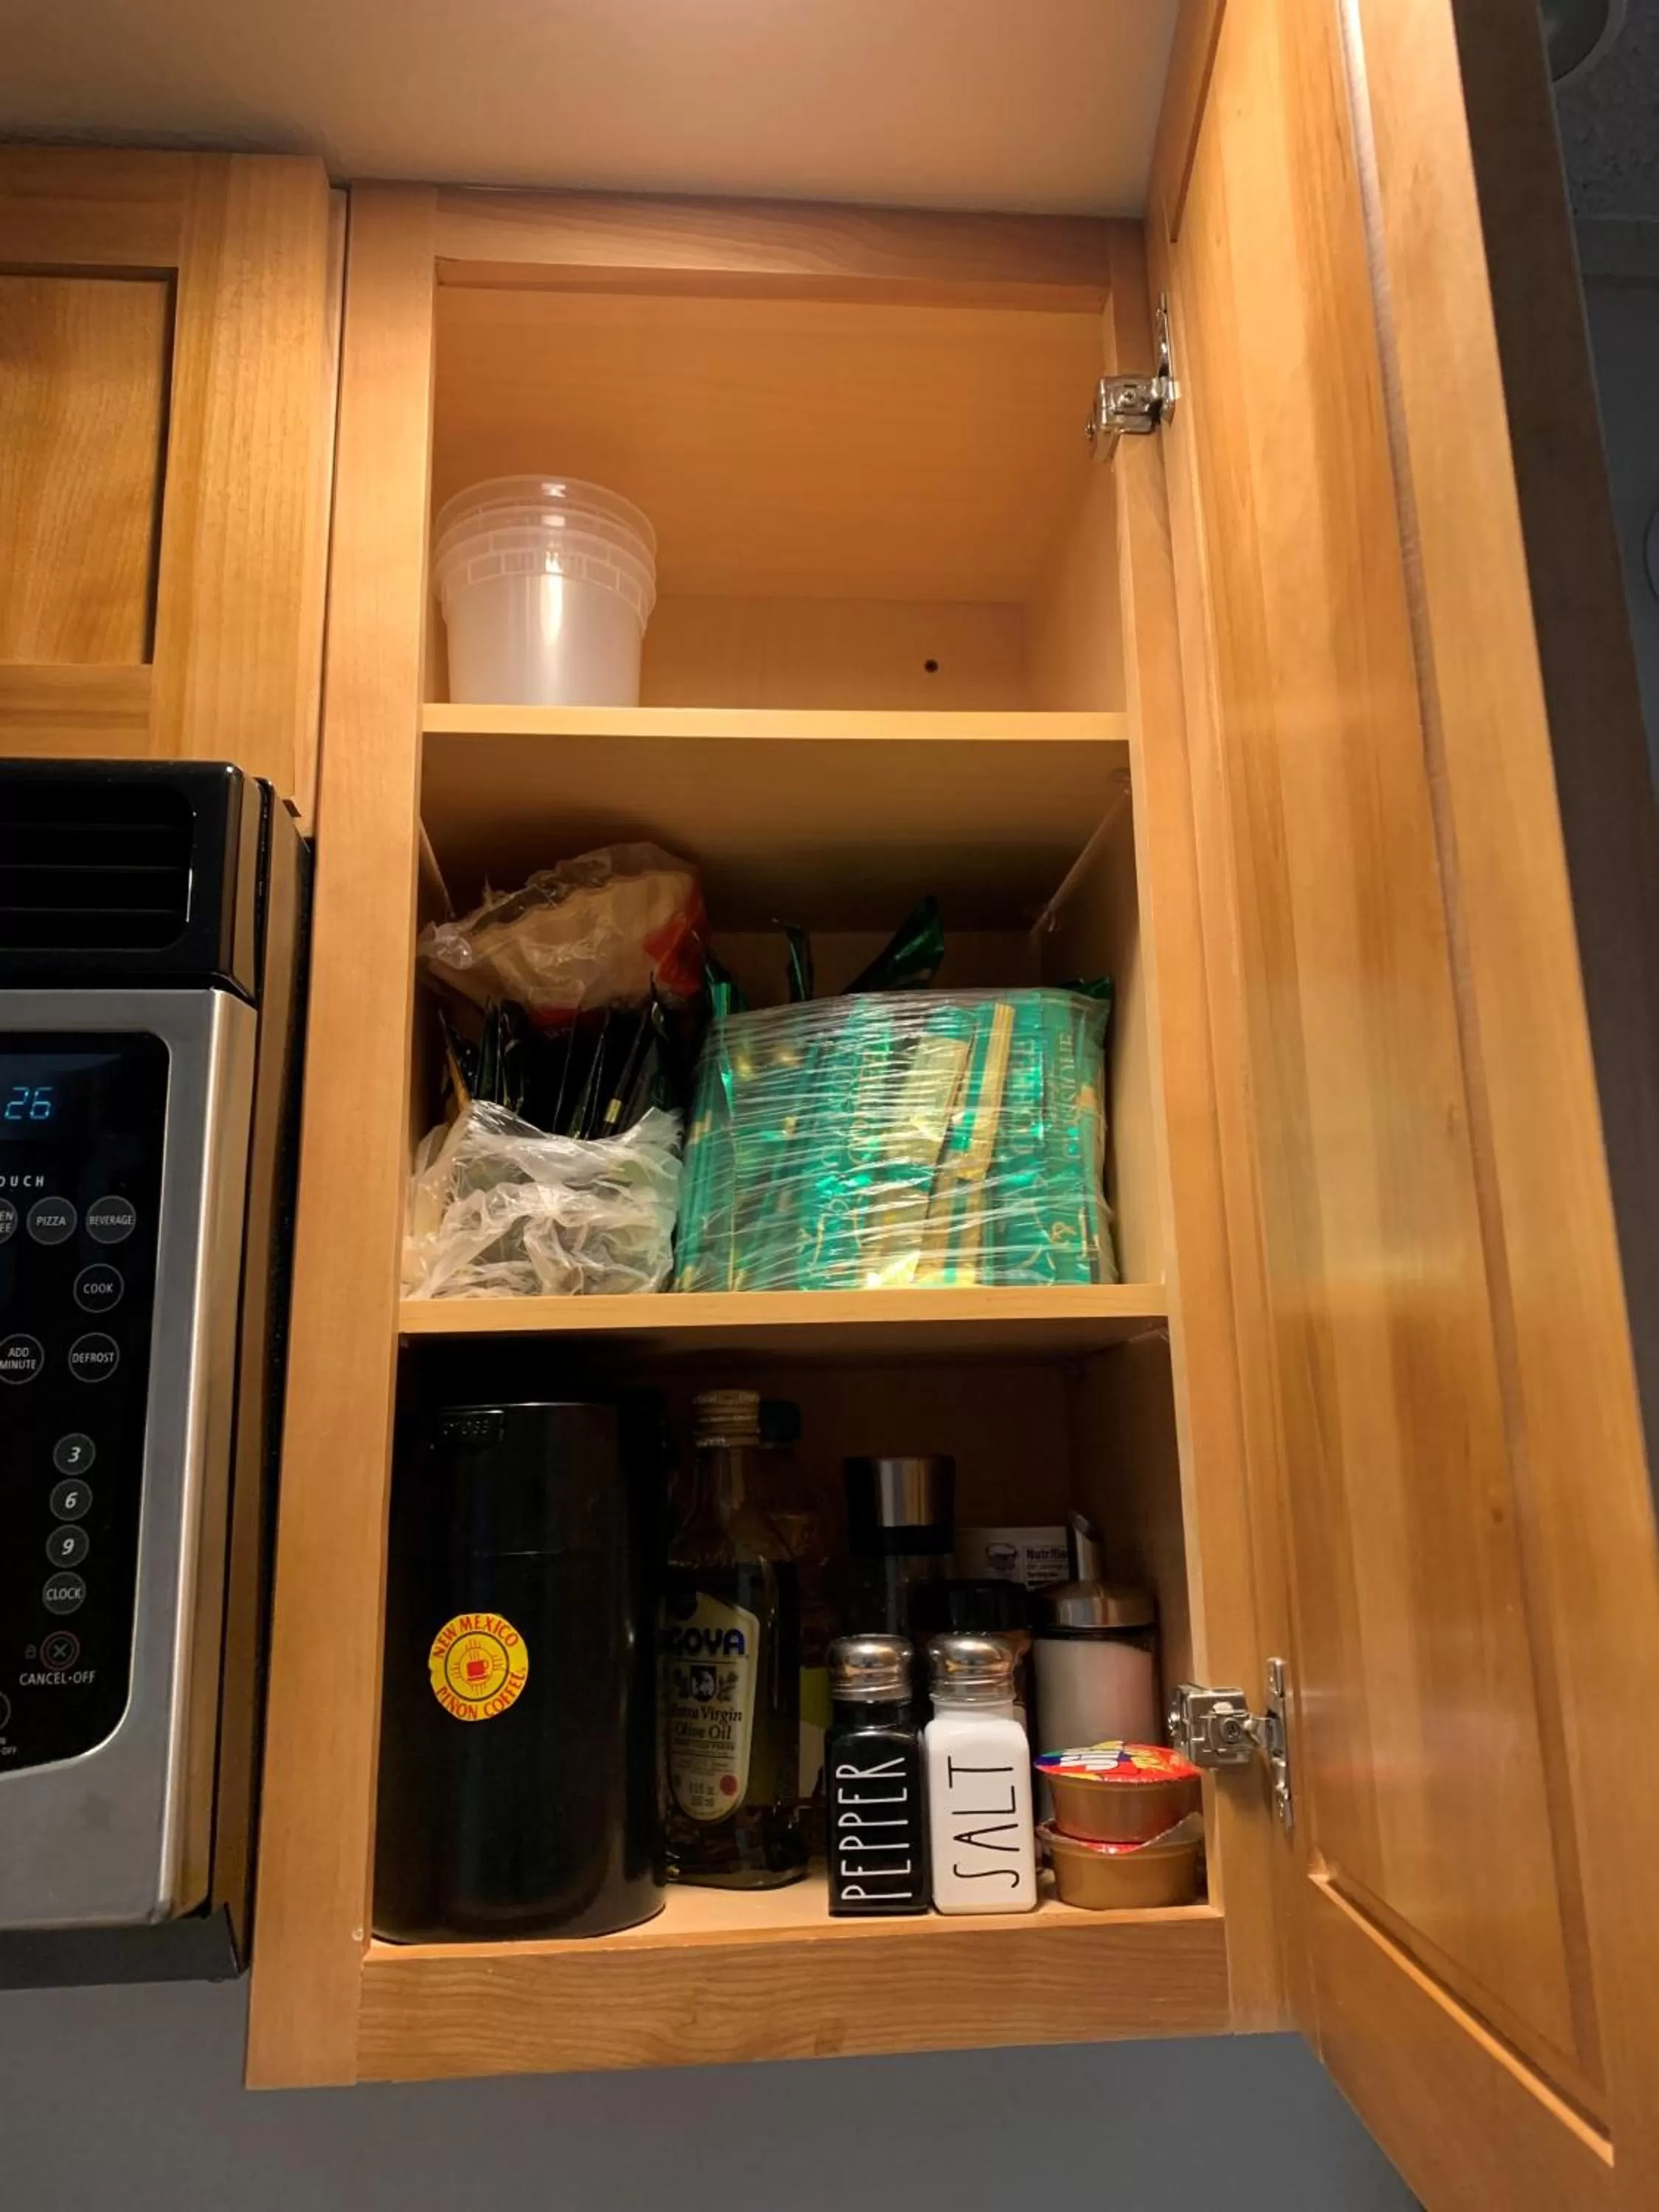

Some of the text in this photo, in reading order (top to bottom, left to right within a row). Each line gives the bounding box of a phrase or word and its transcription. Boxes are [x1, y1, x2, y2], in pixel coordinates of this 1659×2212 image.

[36, 1216, 67, 1227] PIZZA
[88, 1214, 134, 1225] BEVERAGE
[83, 1282, 114, 1294] COOK
[7, 1347, 29, 1357] ADD
[72, 1352, 114, 1363] DEFROST
[0, 1359, 36, 1370] MINUTE
[67, 1446, 82, 1463] 3
[64, 1492, 79, 1509] 6
[61, 1538, 74, 1556] 9
[46, 1587, 83, 1601] CLOCK
[433, 1615, 519, 1659] NEW MEXICO
[665, 1626, 745, 1656] GOYA
[483, 1666, 526, 1717] COFFEE
[700, 1705, 742, 1725] Virgin
[675, 1722, 731, 1740] Olive Oil
[835, 1756, 913, 1901] PEPPER
[947, 1755, 1021, 1889] SALT
